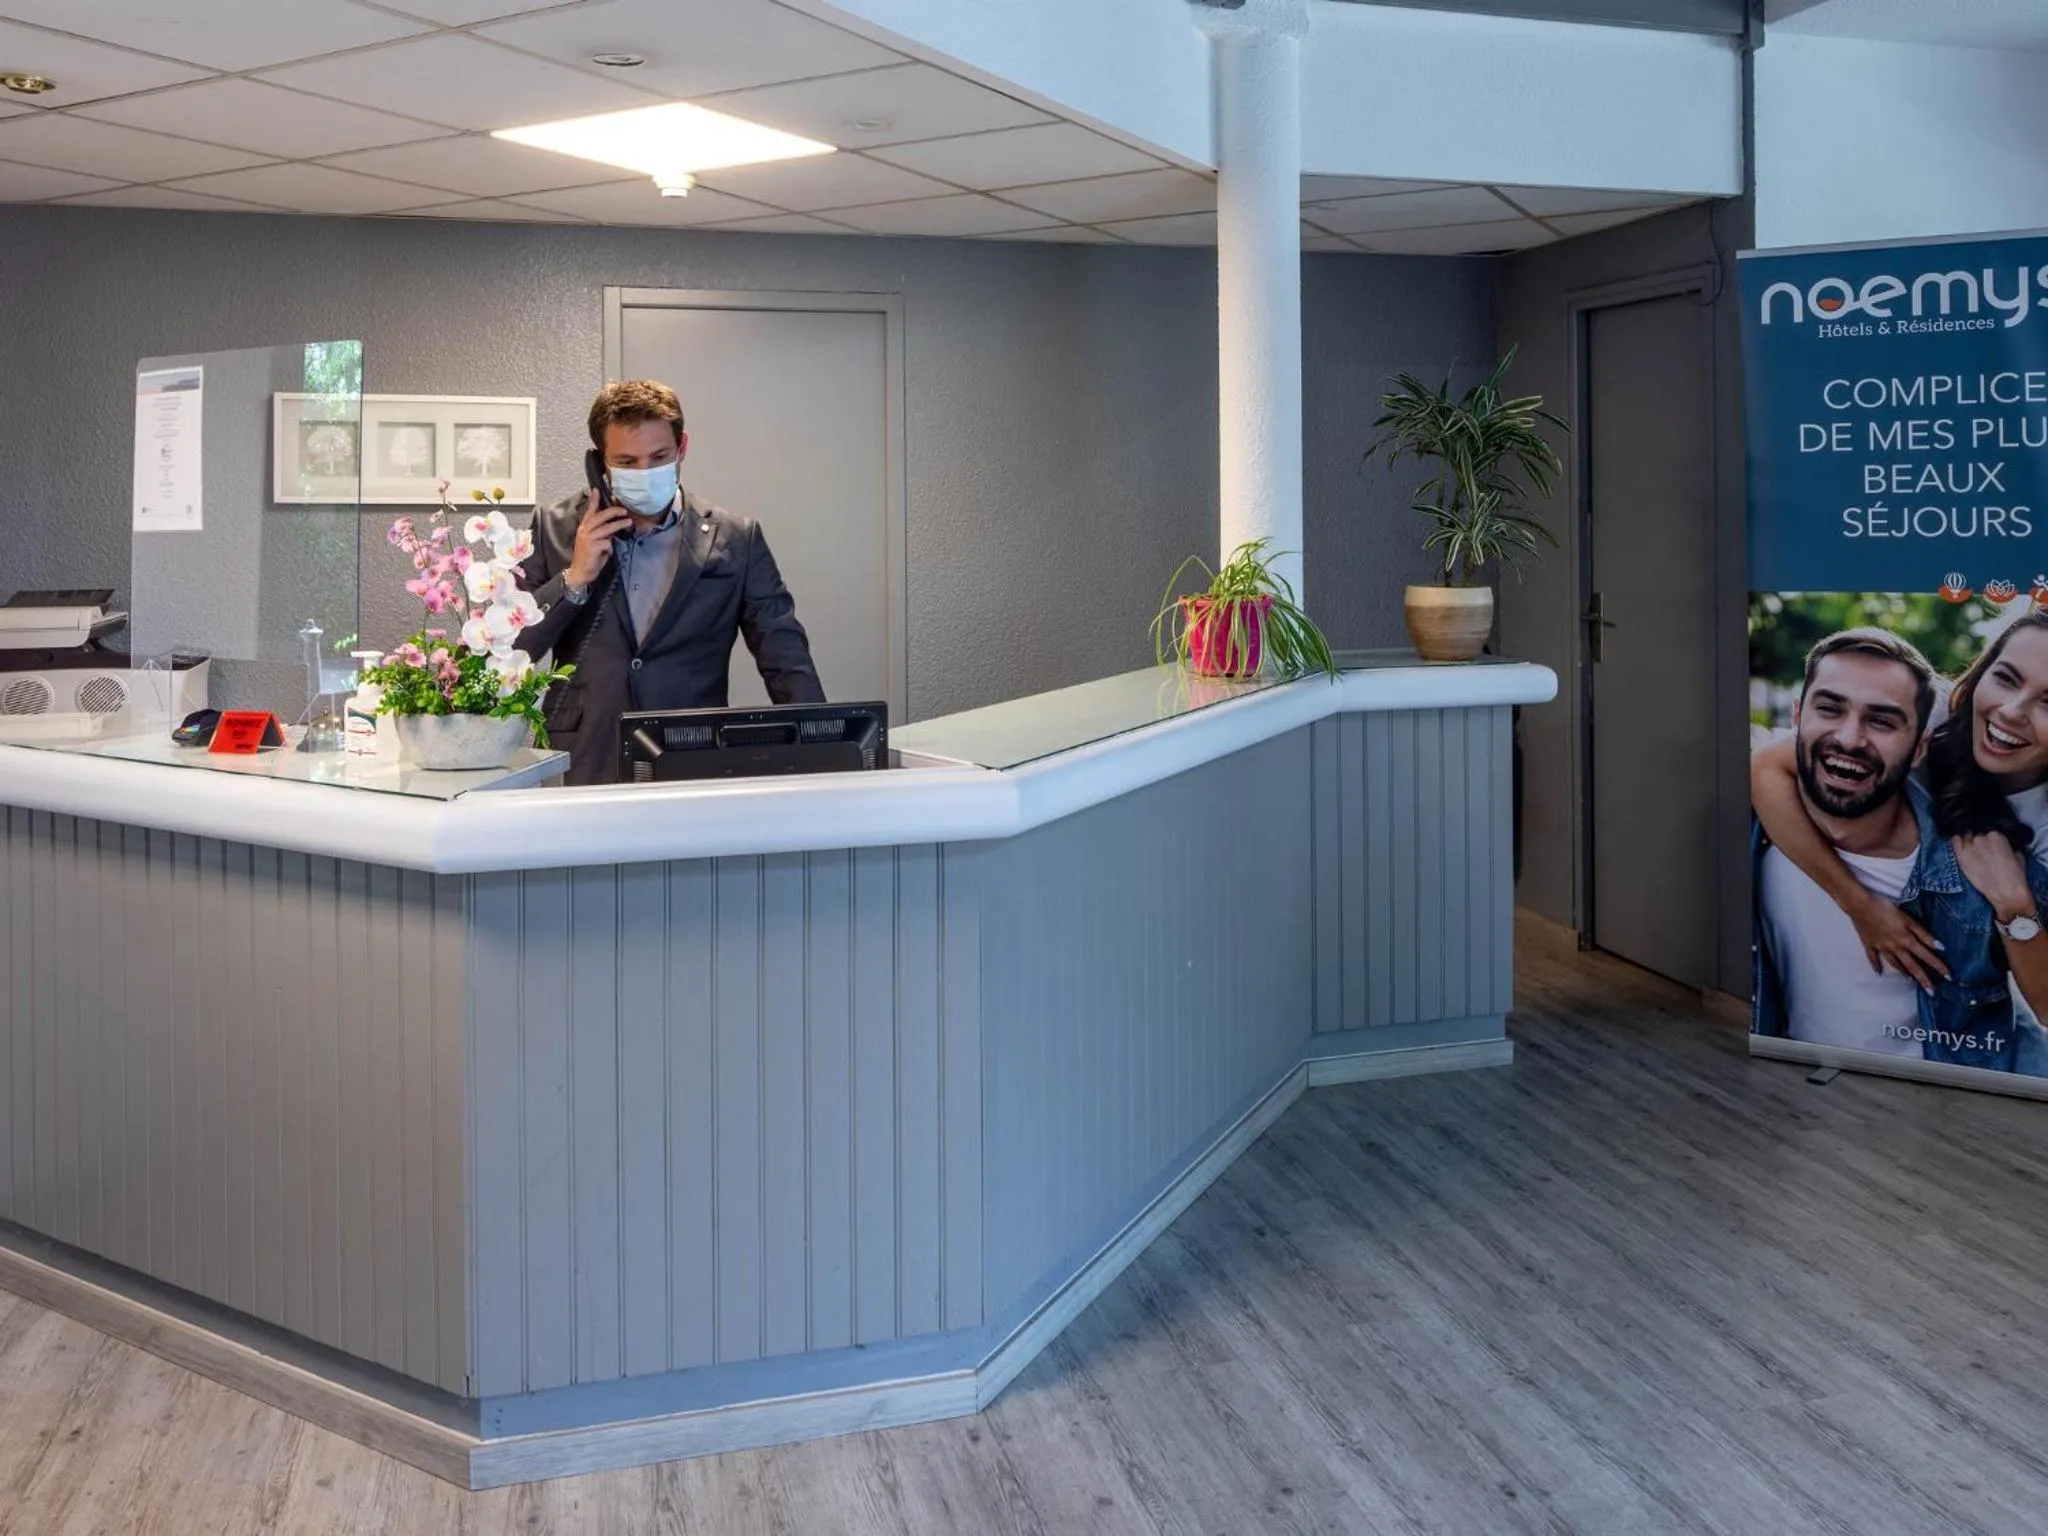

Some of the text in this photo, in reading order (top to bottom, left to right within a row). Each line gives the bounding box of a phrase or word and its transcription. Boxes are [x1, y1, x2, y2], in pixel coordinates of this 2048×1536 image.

[1818, 317, 1996, 338] Hôtels & Résidences
[1823, 371, 2048, 410] COMPLICE
[1800, 416, 2048, 452] DE MES PLU
[1863, 461, 2006, 494] BEAUX
[1841, 501, 2033, 537] SÉJOURS
[1881, 1021, 2006, 1052] noemys.fr
